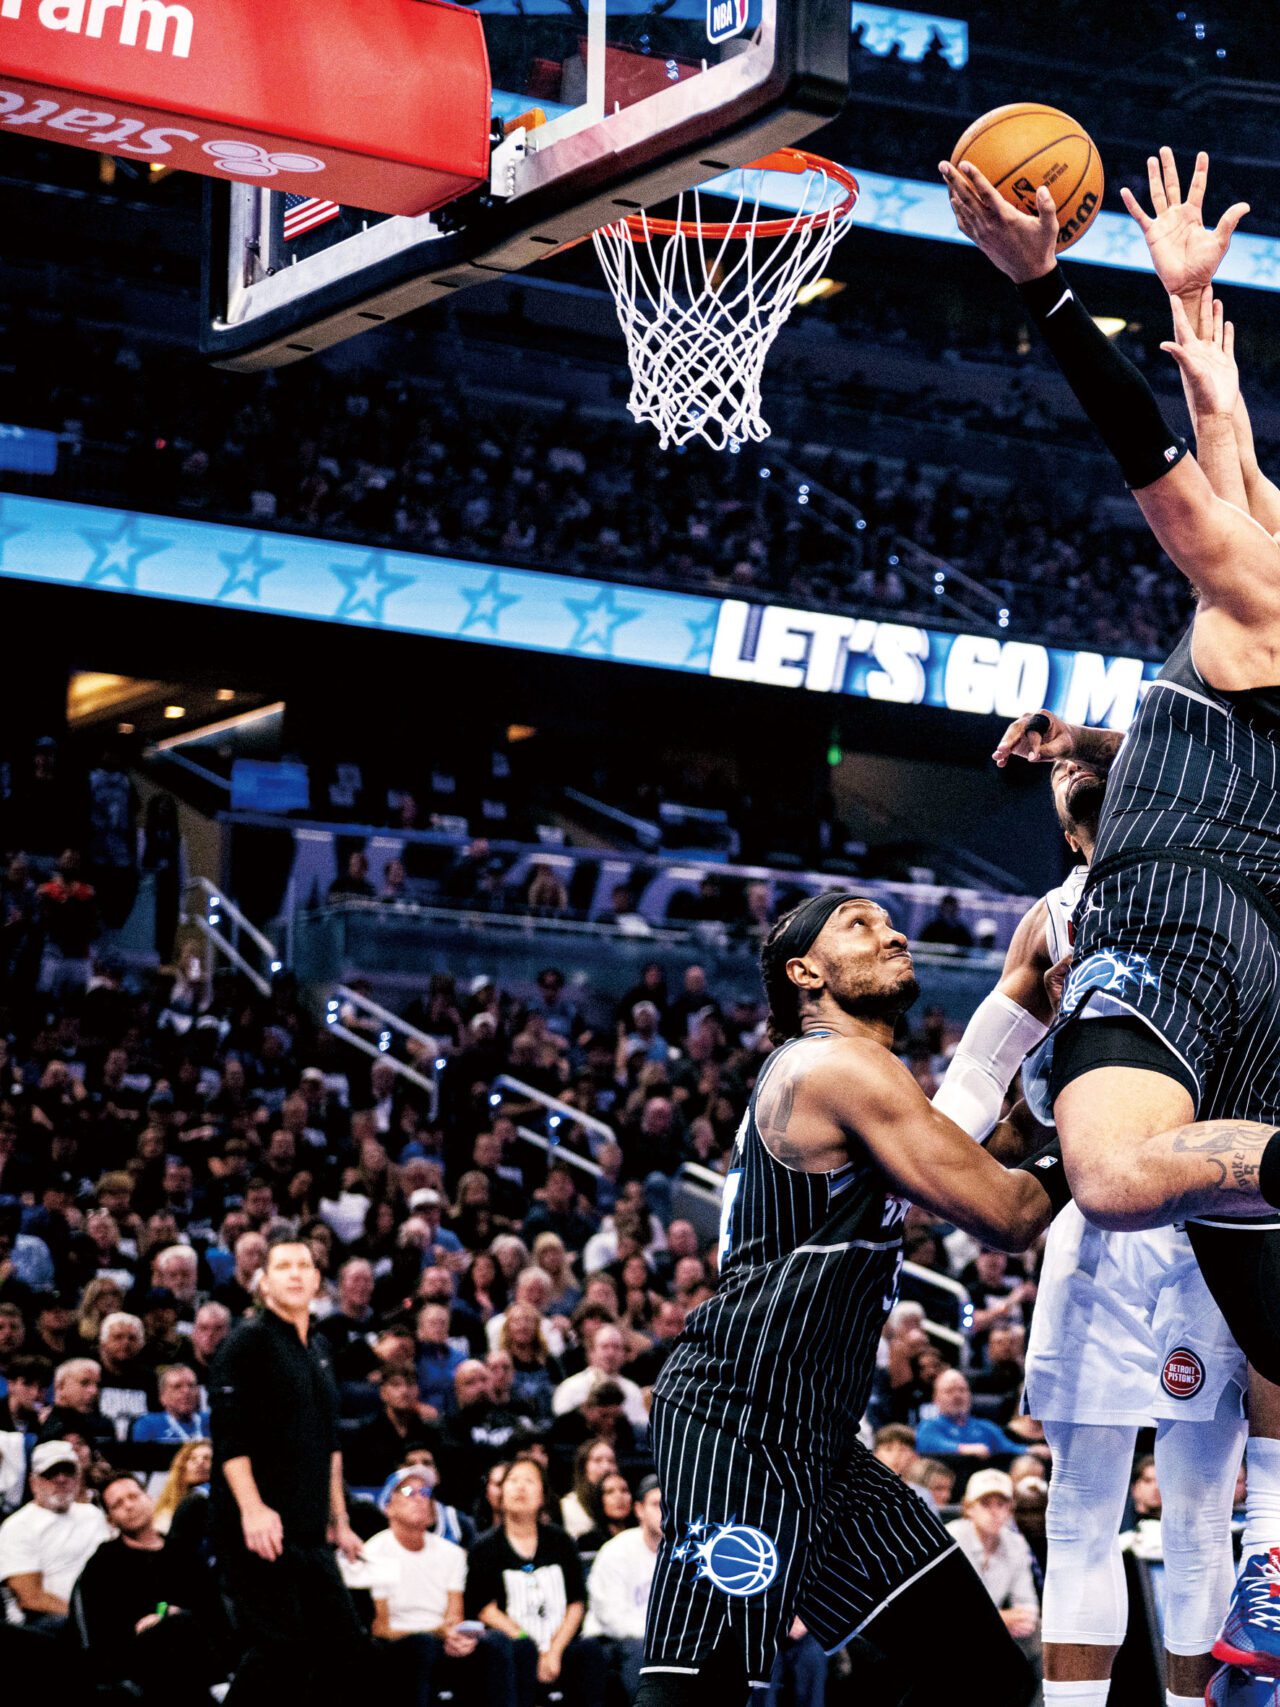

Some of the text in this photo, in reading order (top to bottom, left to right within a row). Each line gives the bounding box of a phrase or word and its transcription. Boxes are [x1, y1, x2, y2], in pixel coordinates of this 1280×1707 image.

[0, 0, 194, 58] arm
[713, 0, 733, 32] NBA
[709, 598, 928, 704] LET'S
[944, 634, 1050, 717] GO
[1167, 1371, 1196, 1384] PISTONS
[1169, 1363, 1196, 1375] DETROIT
